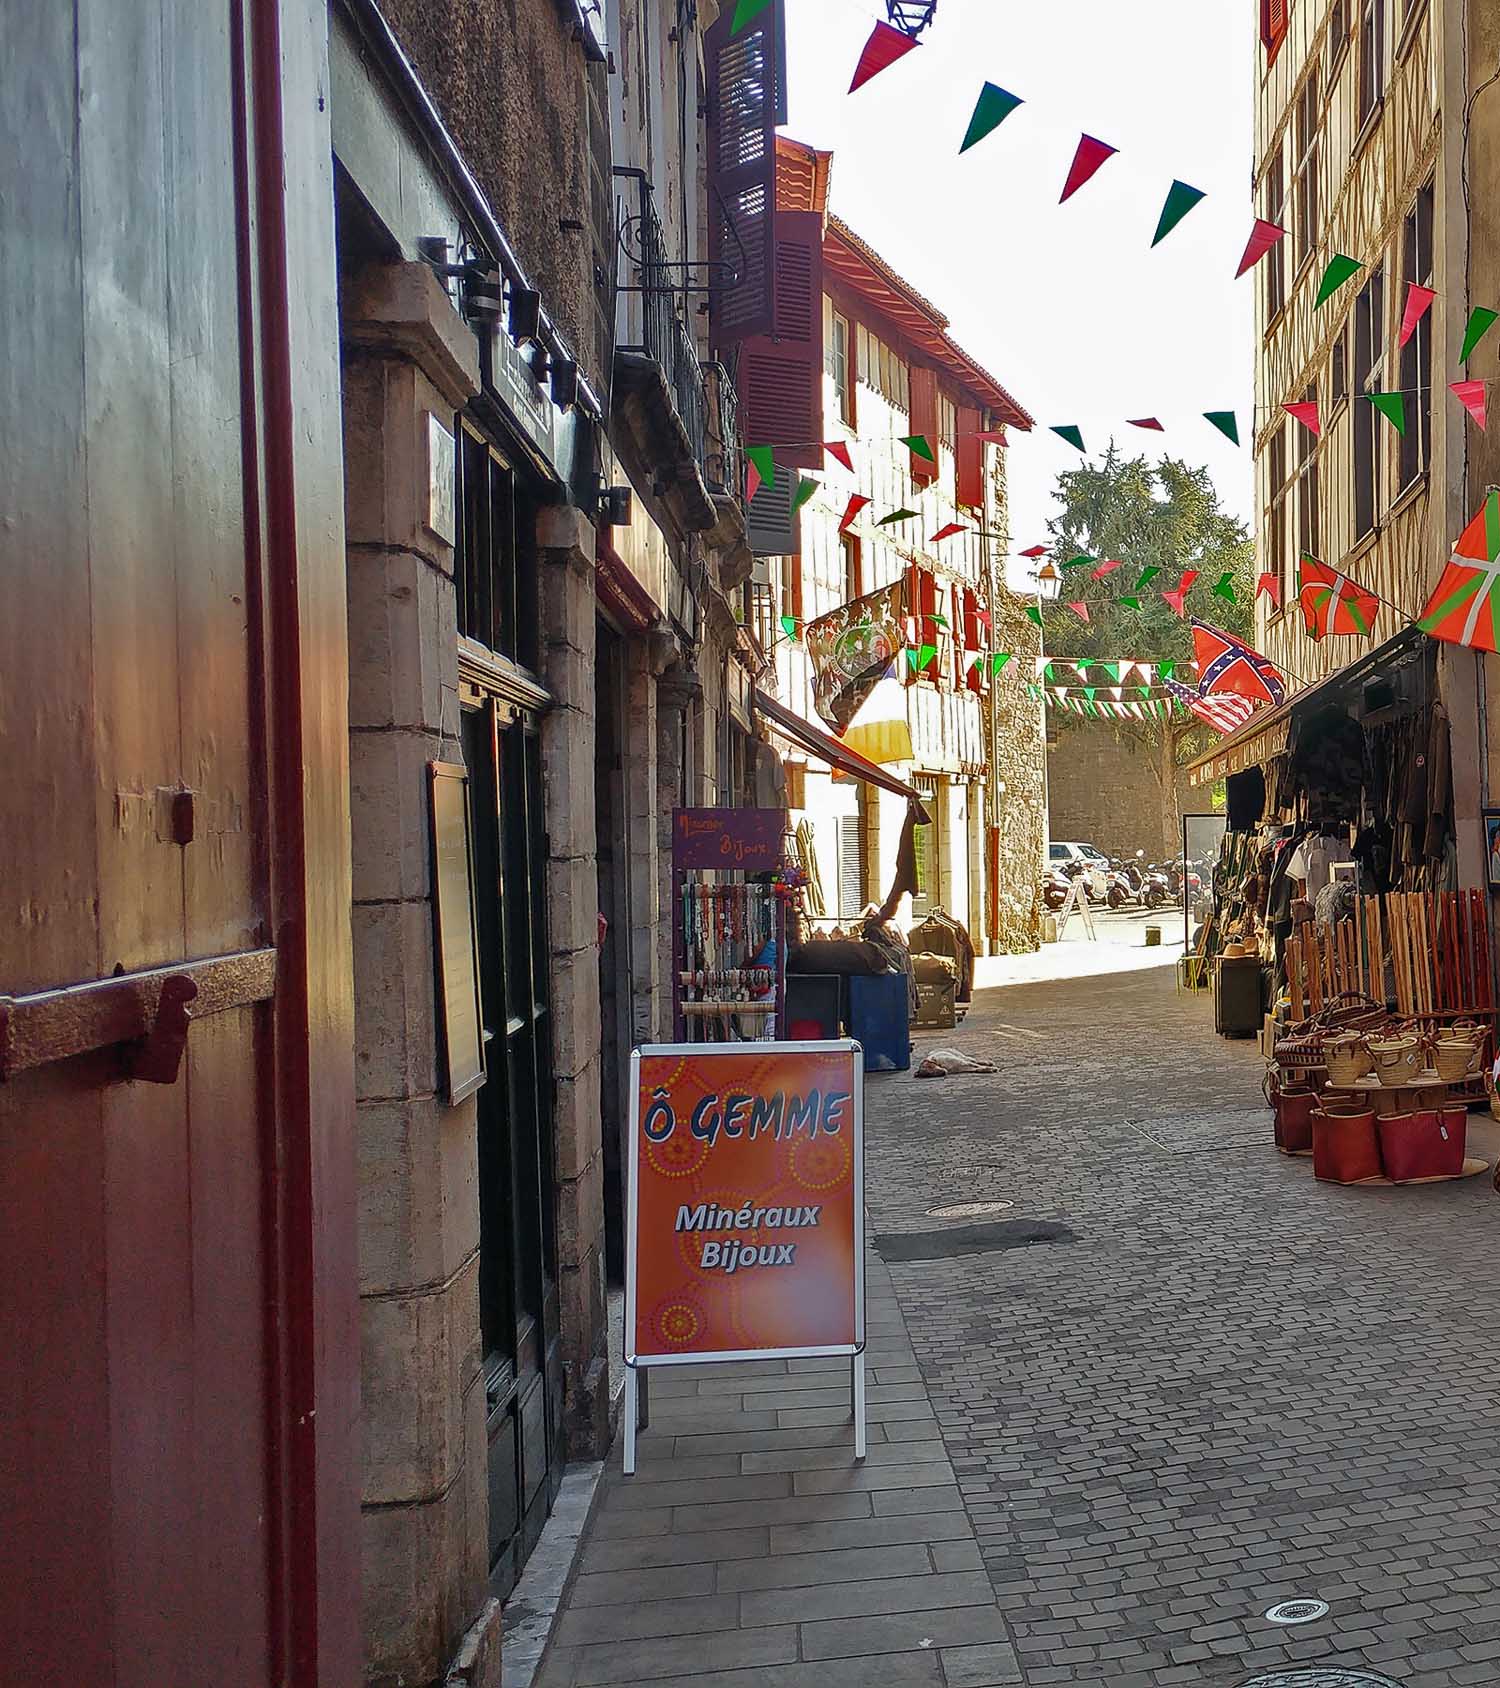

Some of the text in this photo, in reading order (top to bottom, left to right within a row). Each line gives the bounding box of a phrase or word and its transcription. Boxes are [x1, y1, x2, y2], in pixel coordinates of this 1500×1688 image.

[690, 1087, 851, 1147] GEMME
[675, 1201, 820, 1232] Minéraux
[700, 1240, 795, 1273] Bijoux
